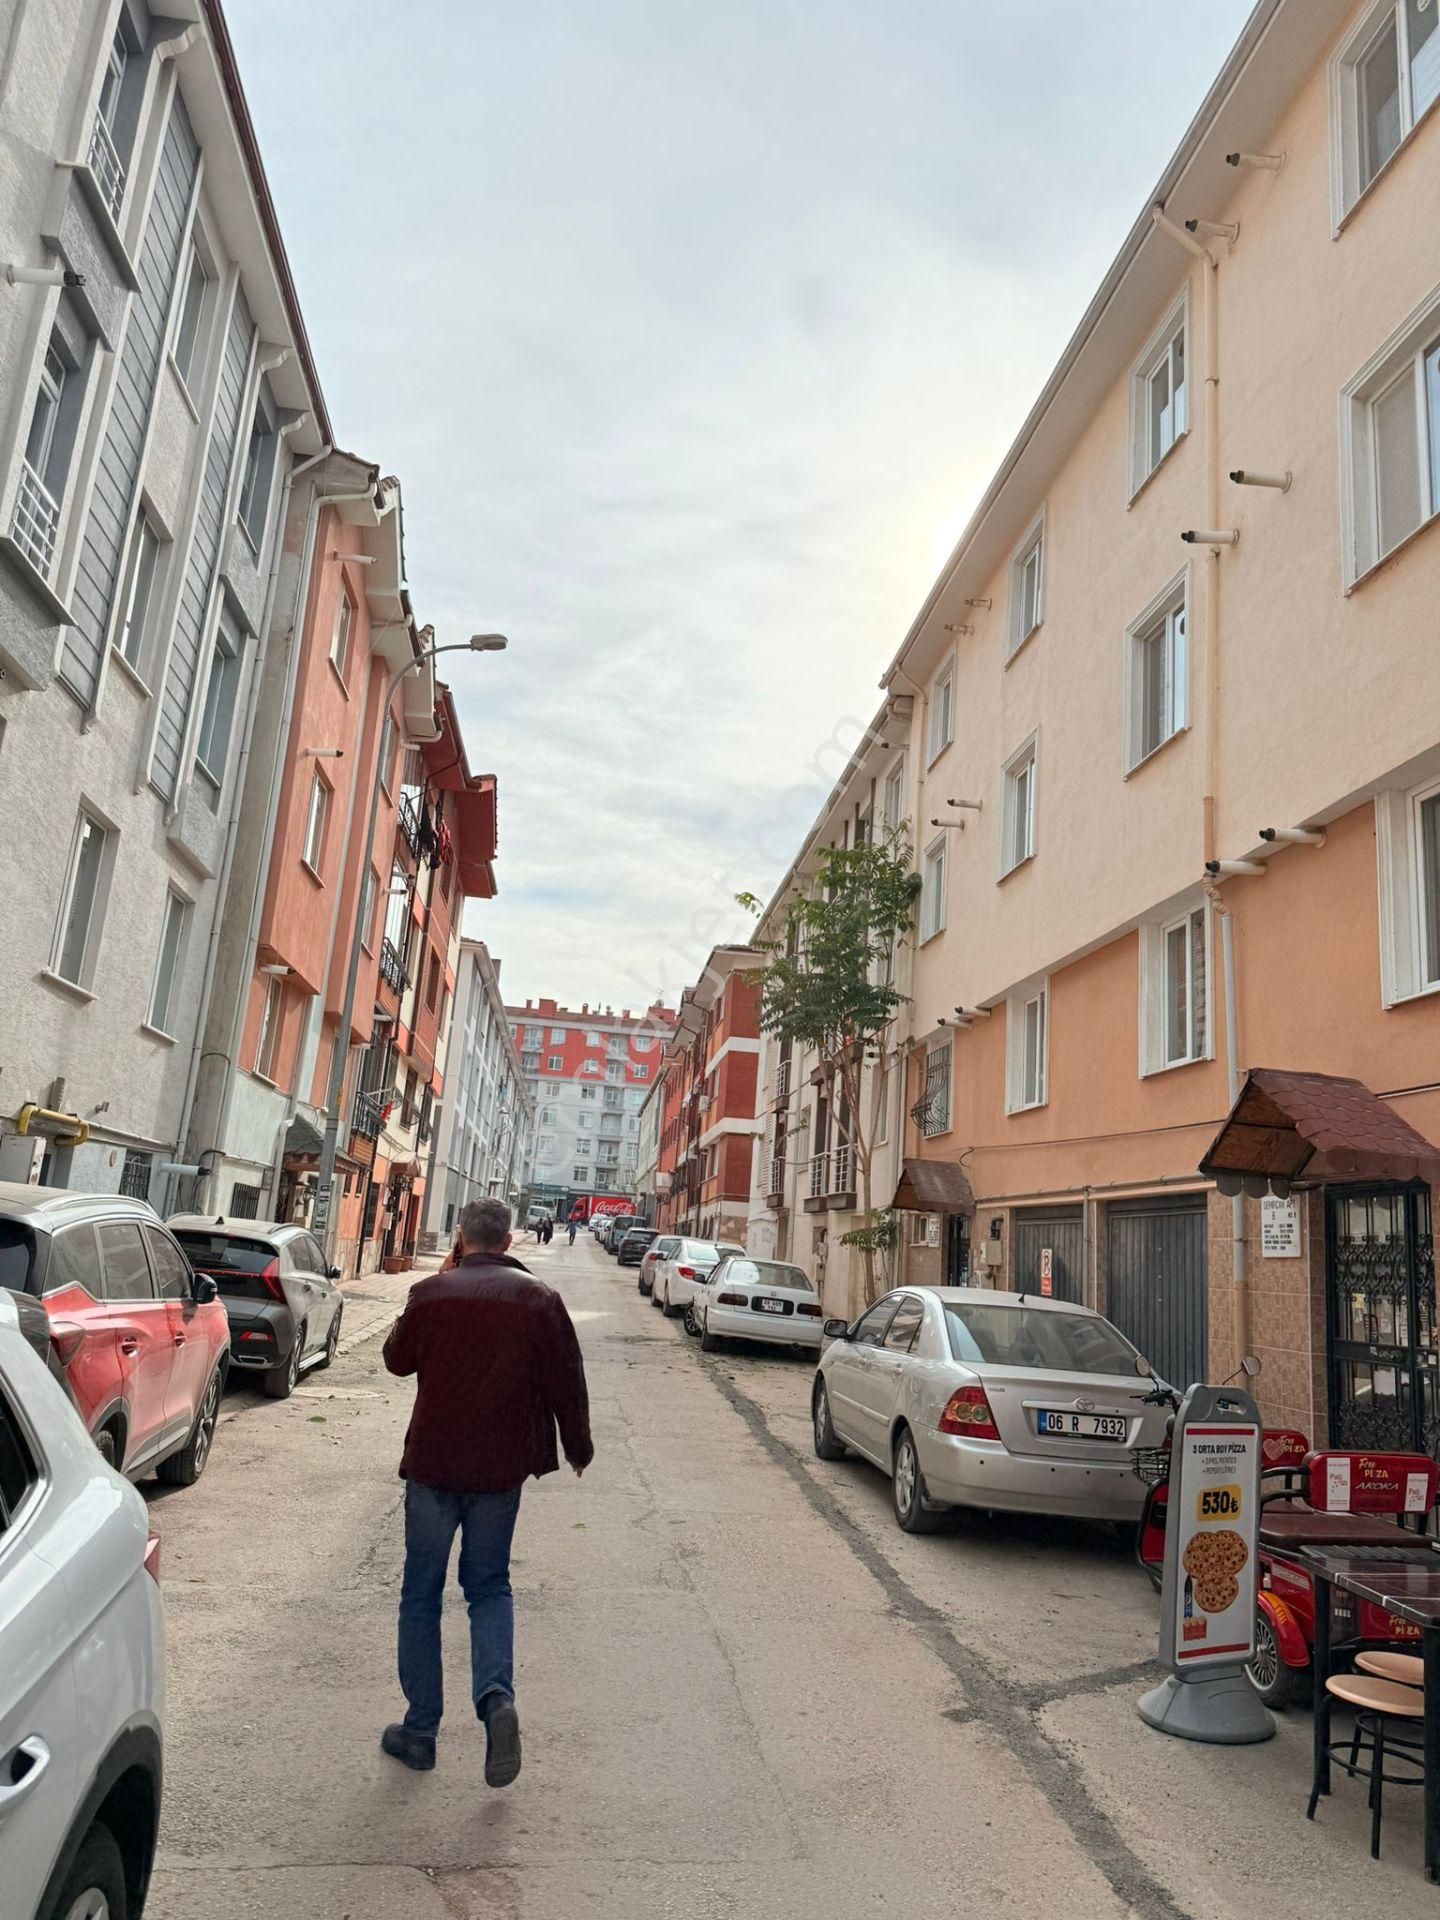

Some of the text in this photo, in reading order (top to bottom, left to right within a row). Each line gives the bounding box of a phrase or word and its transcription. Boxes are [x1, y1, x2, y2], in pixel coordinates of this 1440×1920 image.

[1048, 1414, 1063, 1430] 06
[1072, 1416, 1079, 1432] R
[1093, 1418, 1123, 1435] 7932
[1198, 1445, 1215, 1454] ORTA
[1216, 1445, 1228, 1454] BOY
